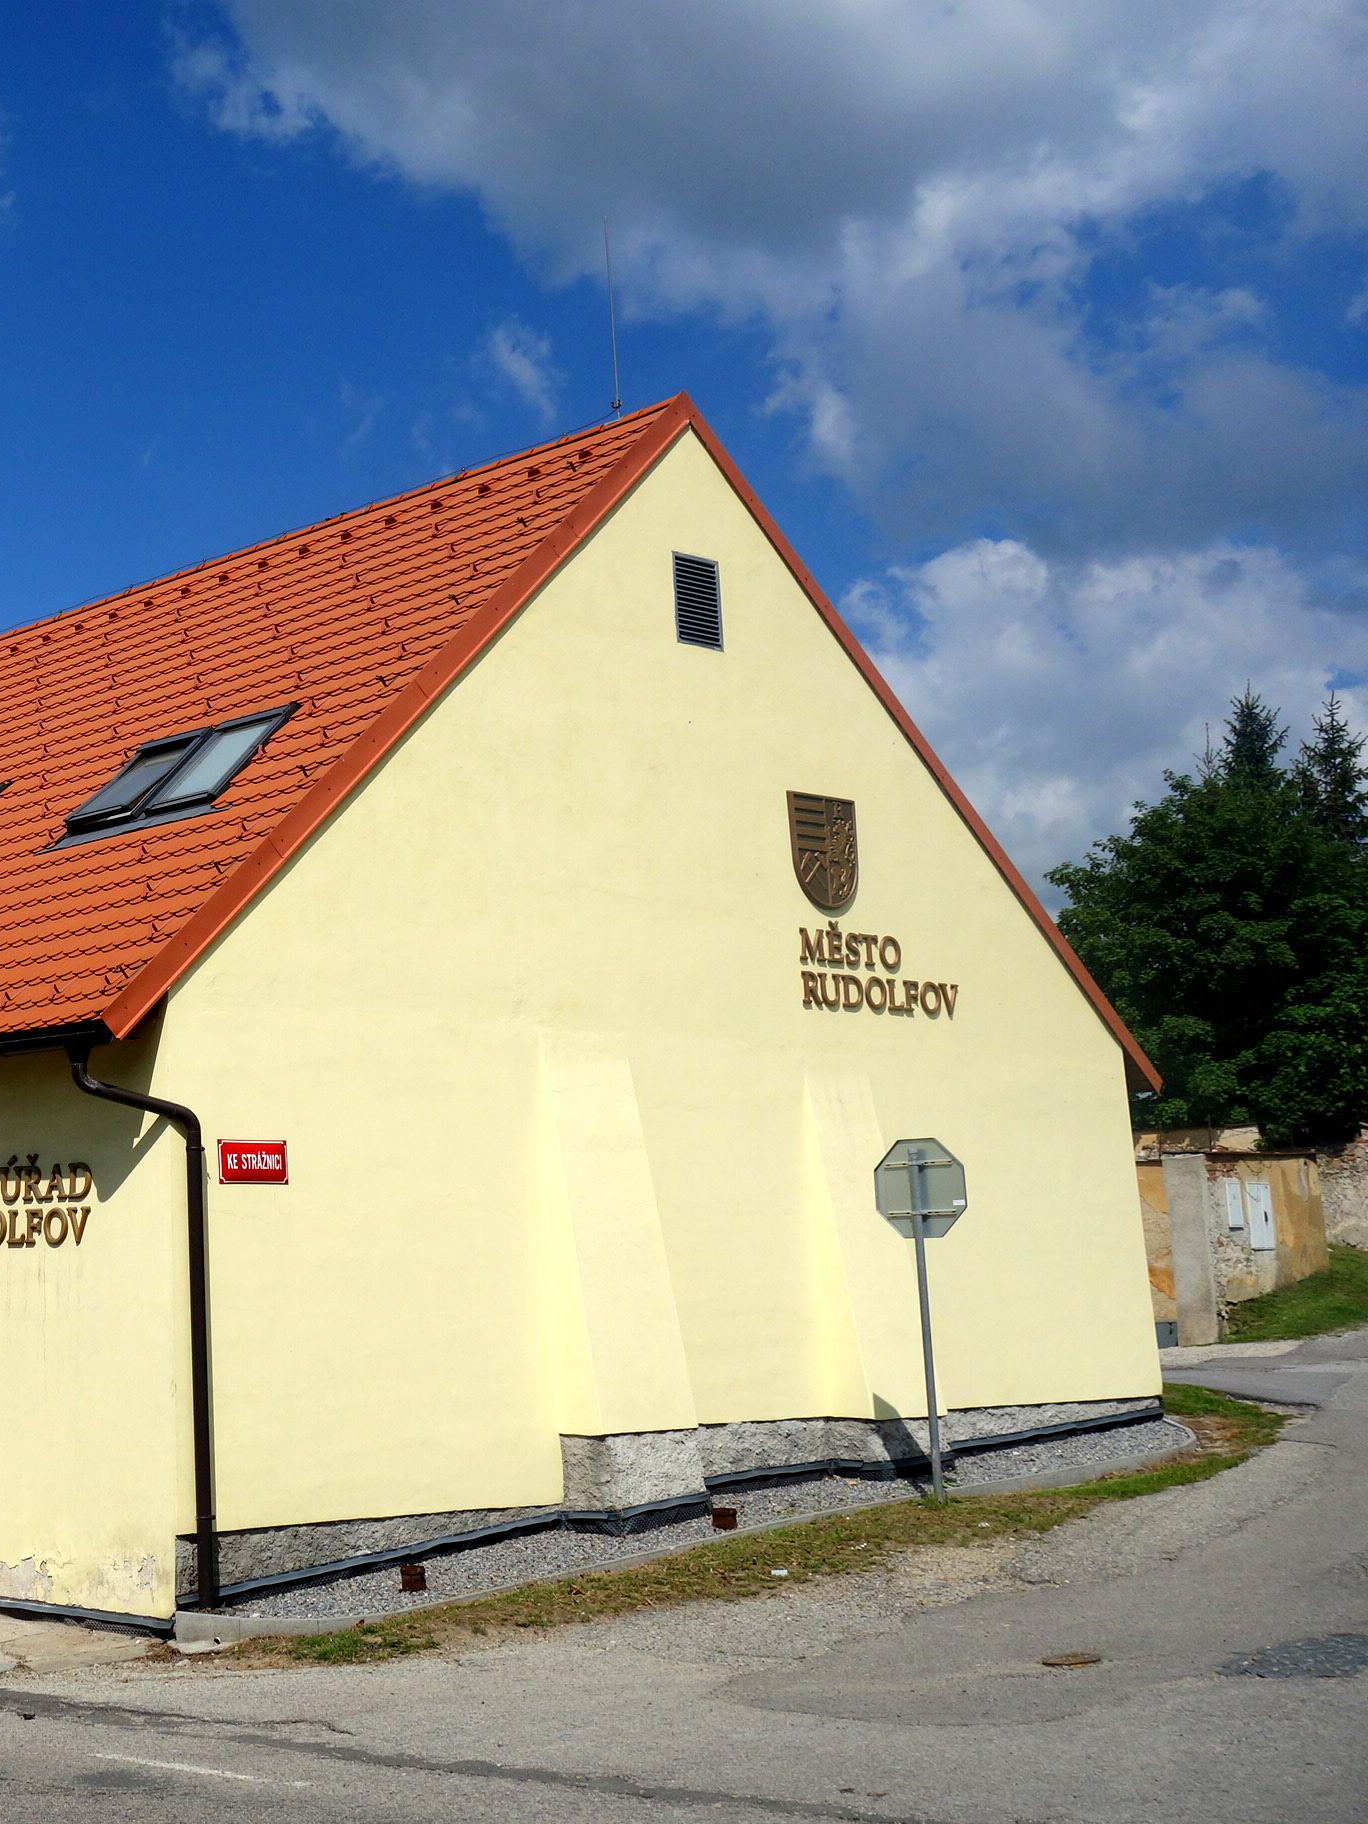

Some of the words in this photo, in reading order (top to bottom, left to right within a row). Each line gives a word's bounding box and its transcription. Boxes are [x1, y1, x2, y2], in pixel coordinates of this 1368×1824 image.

[799, 920, 901, 969] MĚSTO
[801, 971, 959, 1020] RUDOLFOV
[227, 1153, 238, 1169] KE
[241, 1151, 282, 1170] STRÁŽNICI
